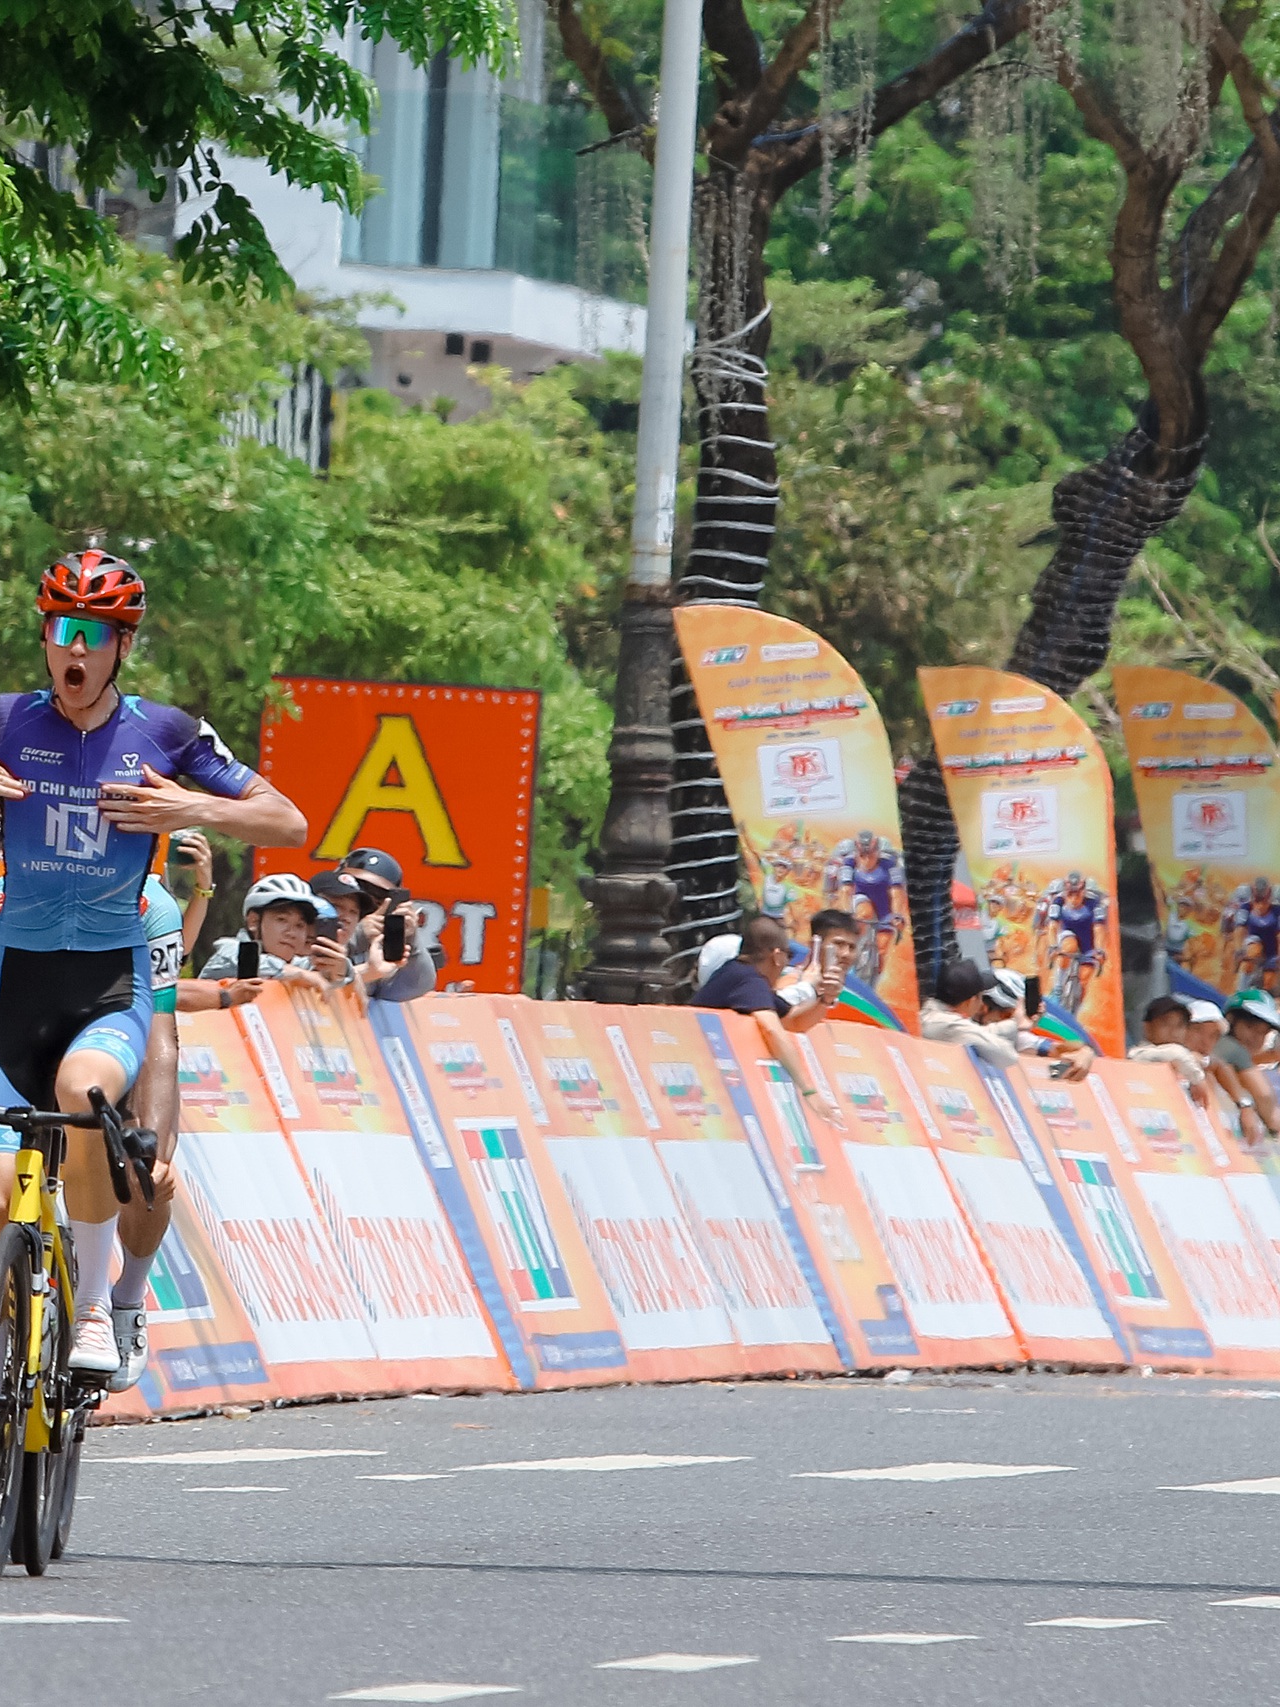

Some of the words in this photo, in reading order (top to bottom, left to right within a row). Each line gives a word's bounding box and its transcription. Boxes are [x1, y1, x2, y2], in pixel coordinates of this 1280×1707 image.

[40, 781, 65, 797] CHI
[309, 713, 472, 868] A
[30, 860, 64, 872] NEW
[66, 862, 117, 878] GROUP
[150, 942, 178, 976] 27
